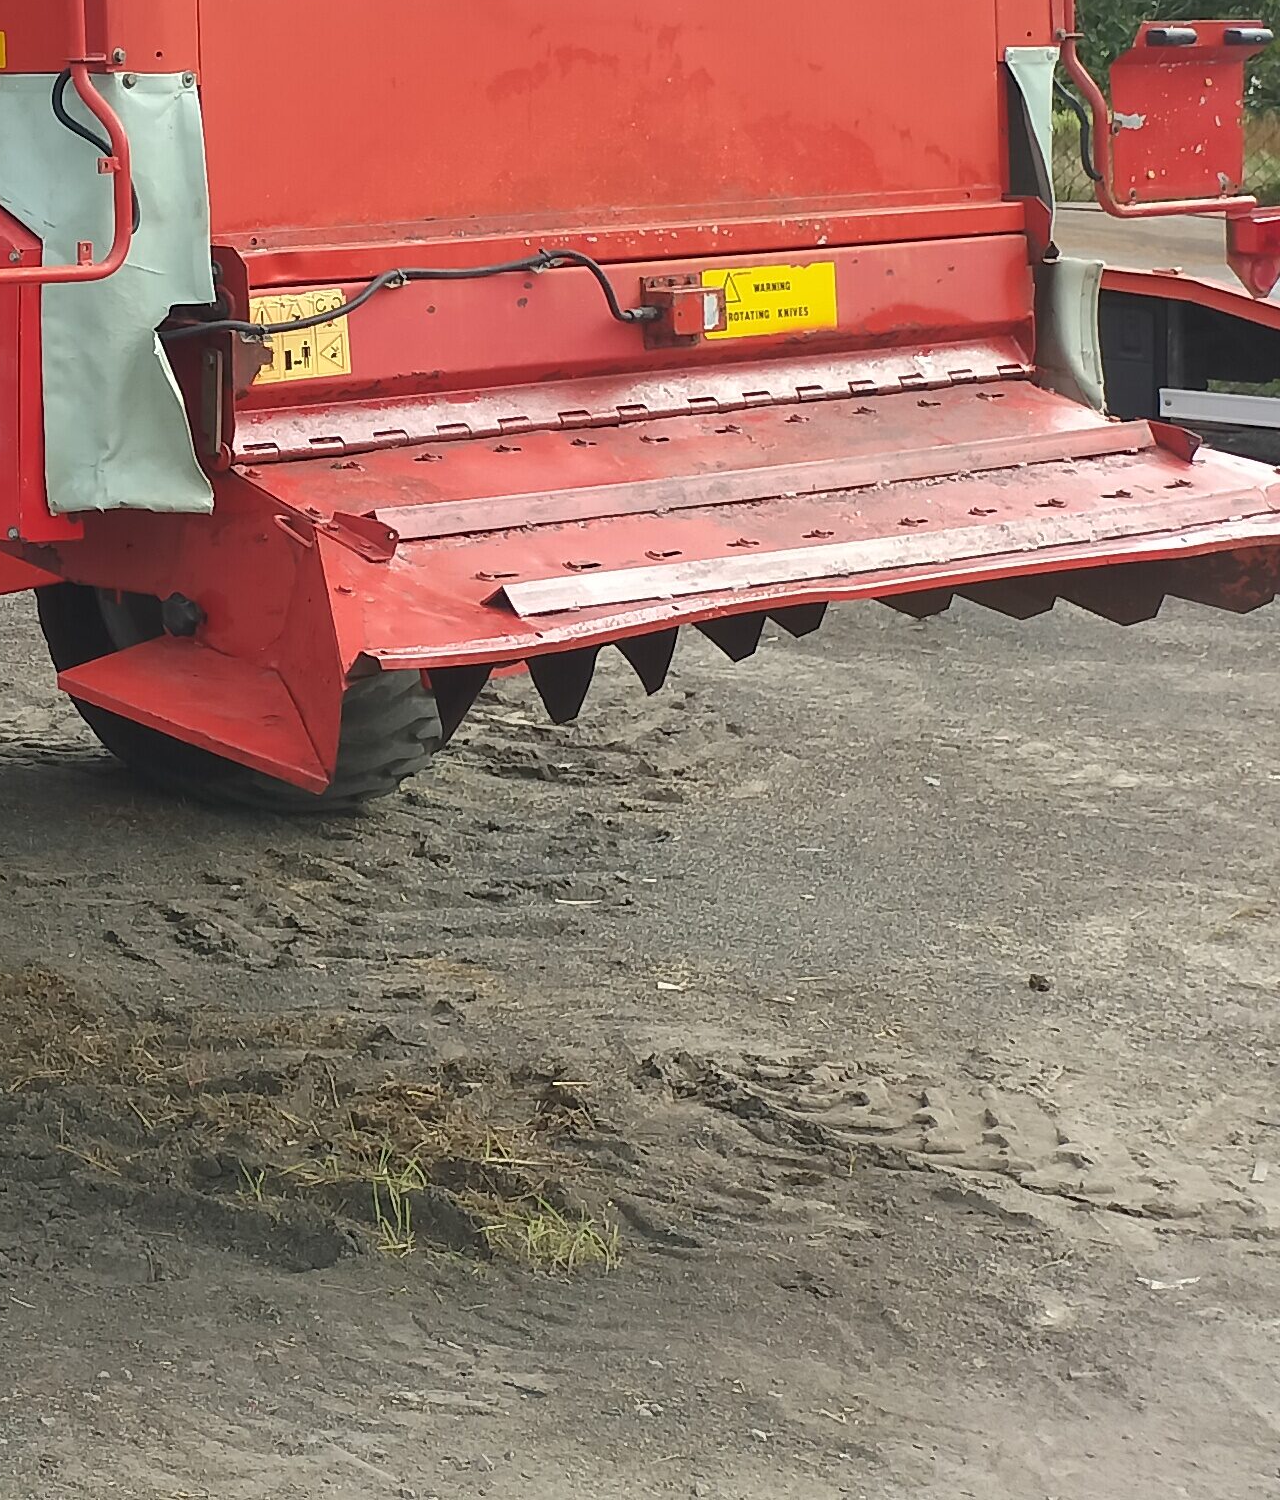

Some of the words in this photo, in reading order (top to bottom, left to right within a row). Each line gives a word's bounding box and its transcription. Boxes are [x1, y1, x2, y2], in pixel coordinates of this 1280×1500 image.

[753, 280, 791, 293] WARNING
[728, 309, 770, 322] ROTATING
[777, 306, 809, 318] KNIVES
